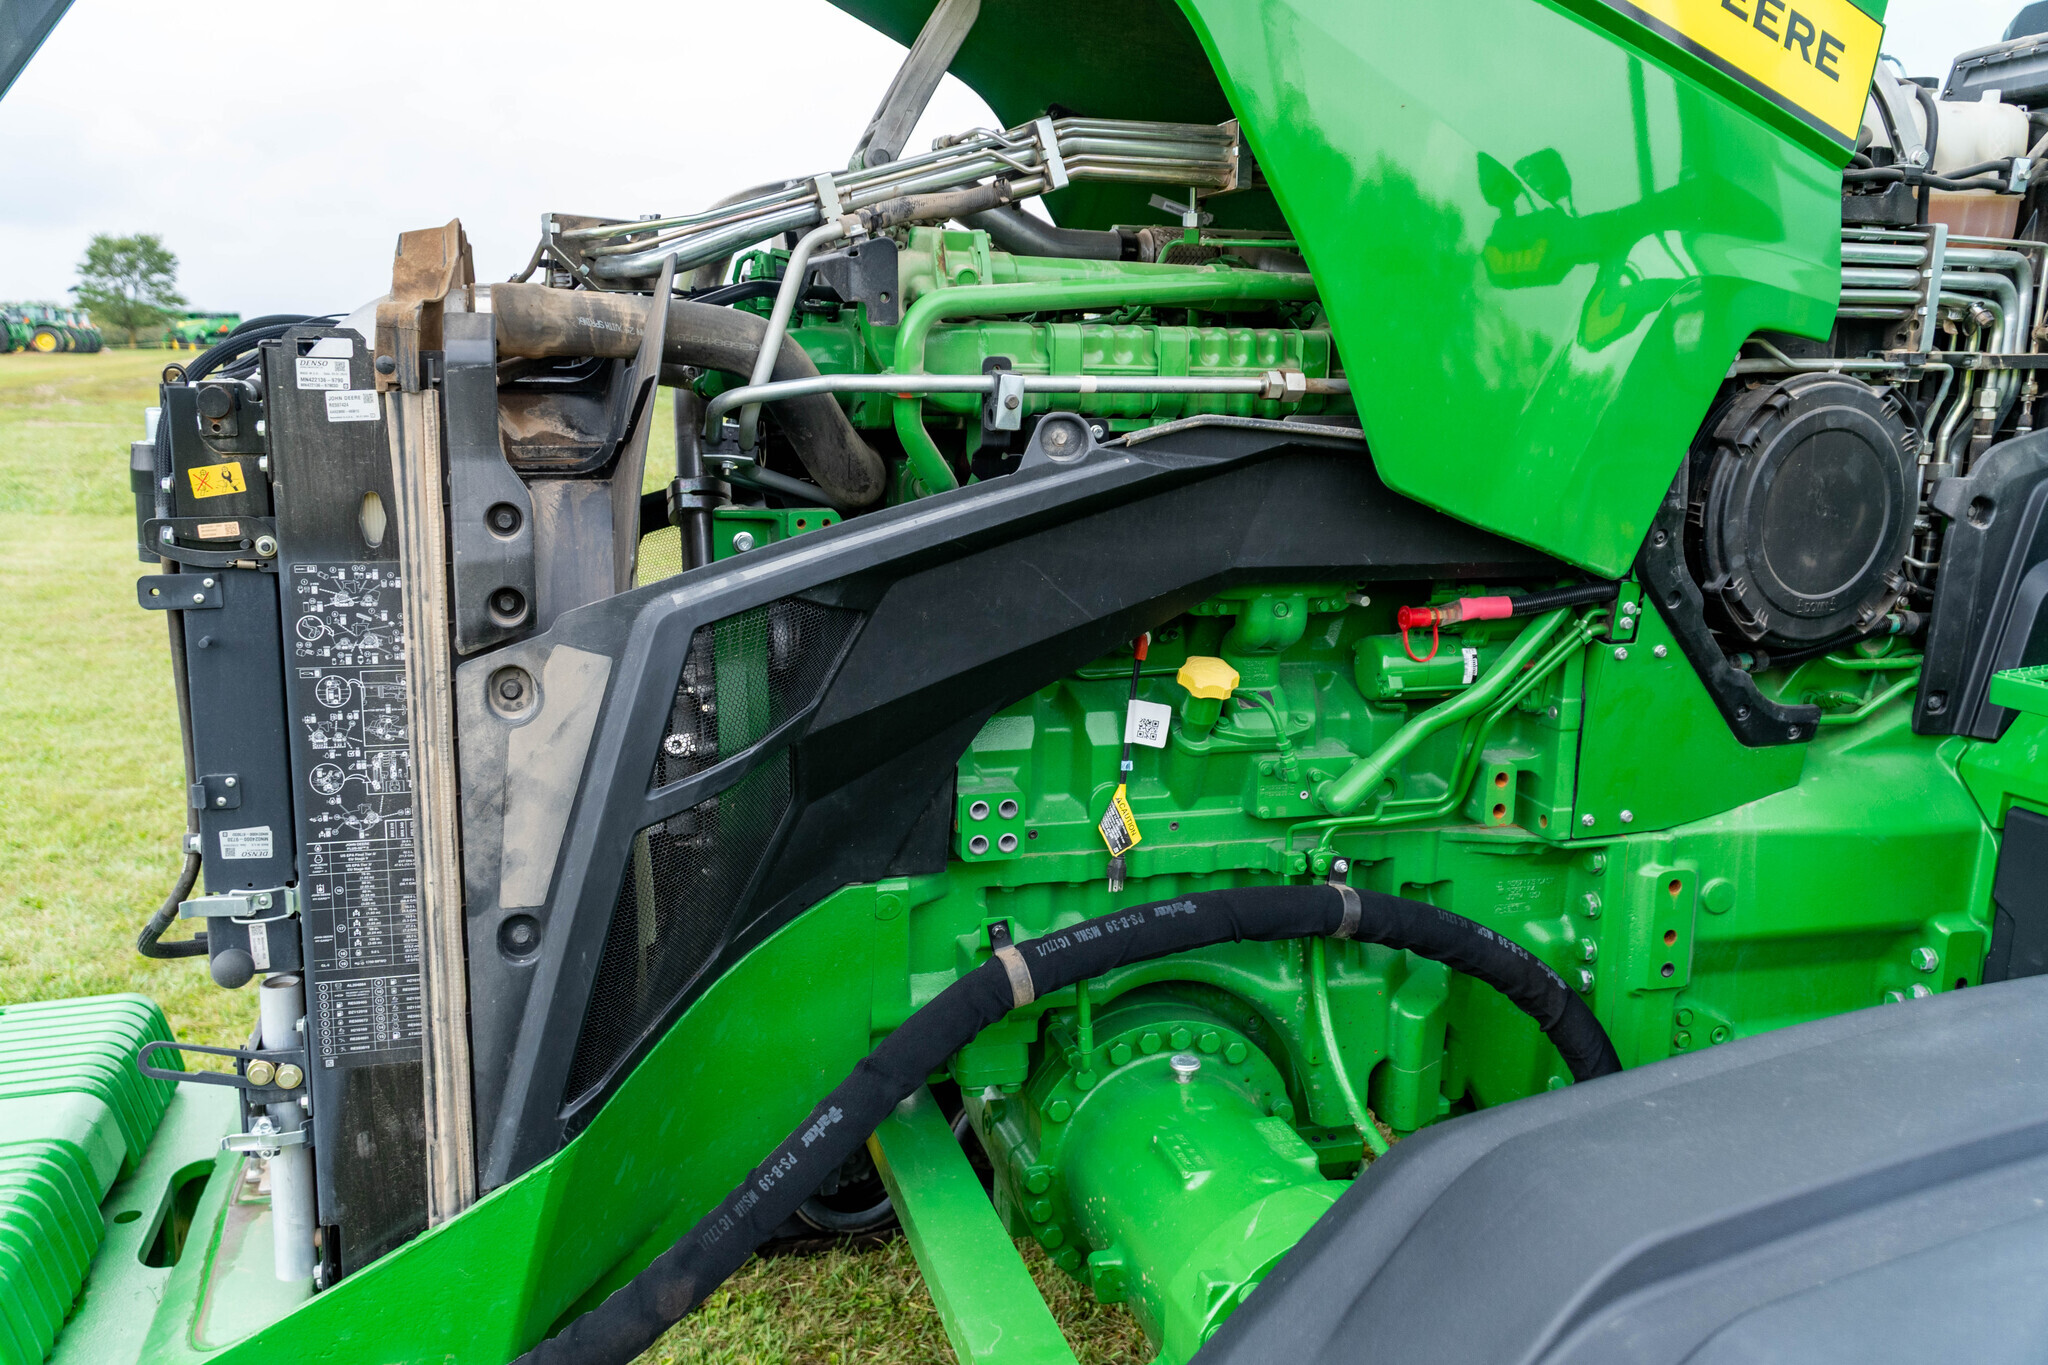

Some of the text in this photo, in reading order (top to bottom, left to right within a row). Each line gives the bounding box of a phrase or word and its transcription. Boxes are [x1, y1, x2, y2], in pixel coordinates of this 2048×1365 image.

[1120, 803, 1136, 836] CAUTION
[1035, 900, 1197, 957] Parker PS-B-39 MSHA IC171/1
[801, 1105, 844, 1148] Parker
[758, 1152, 798, 1192] PS-B-39
[732, 1188, 760, 1218] MSHA
